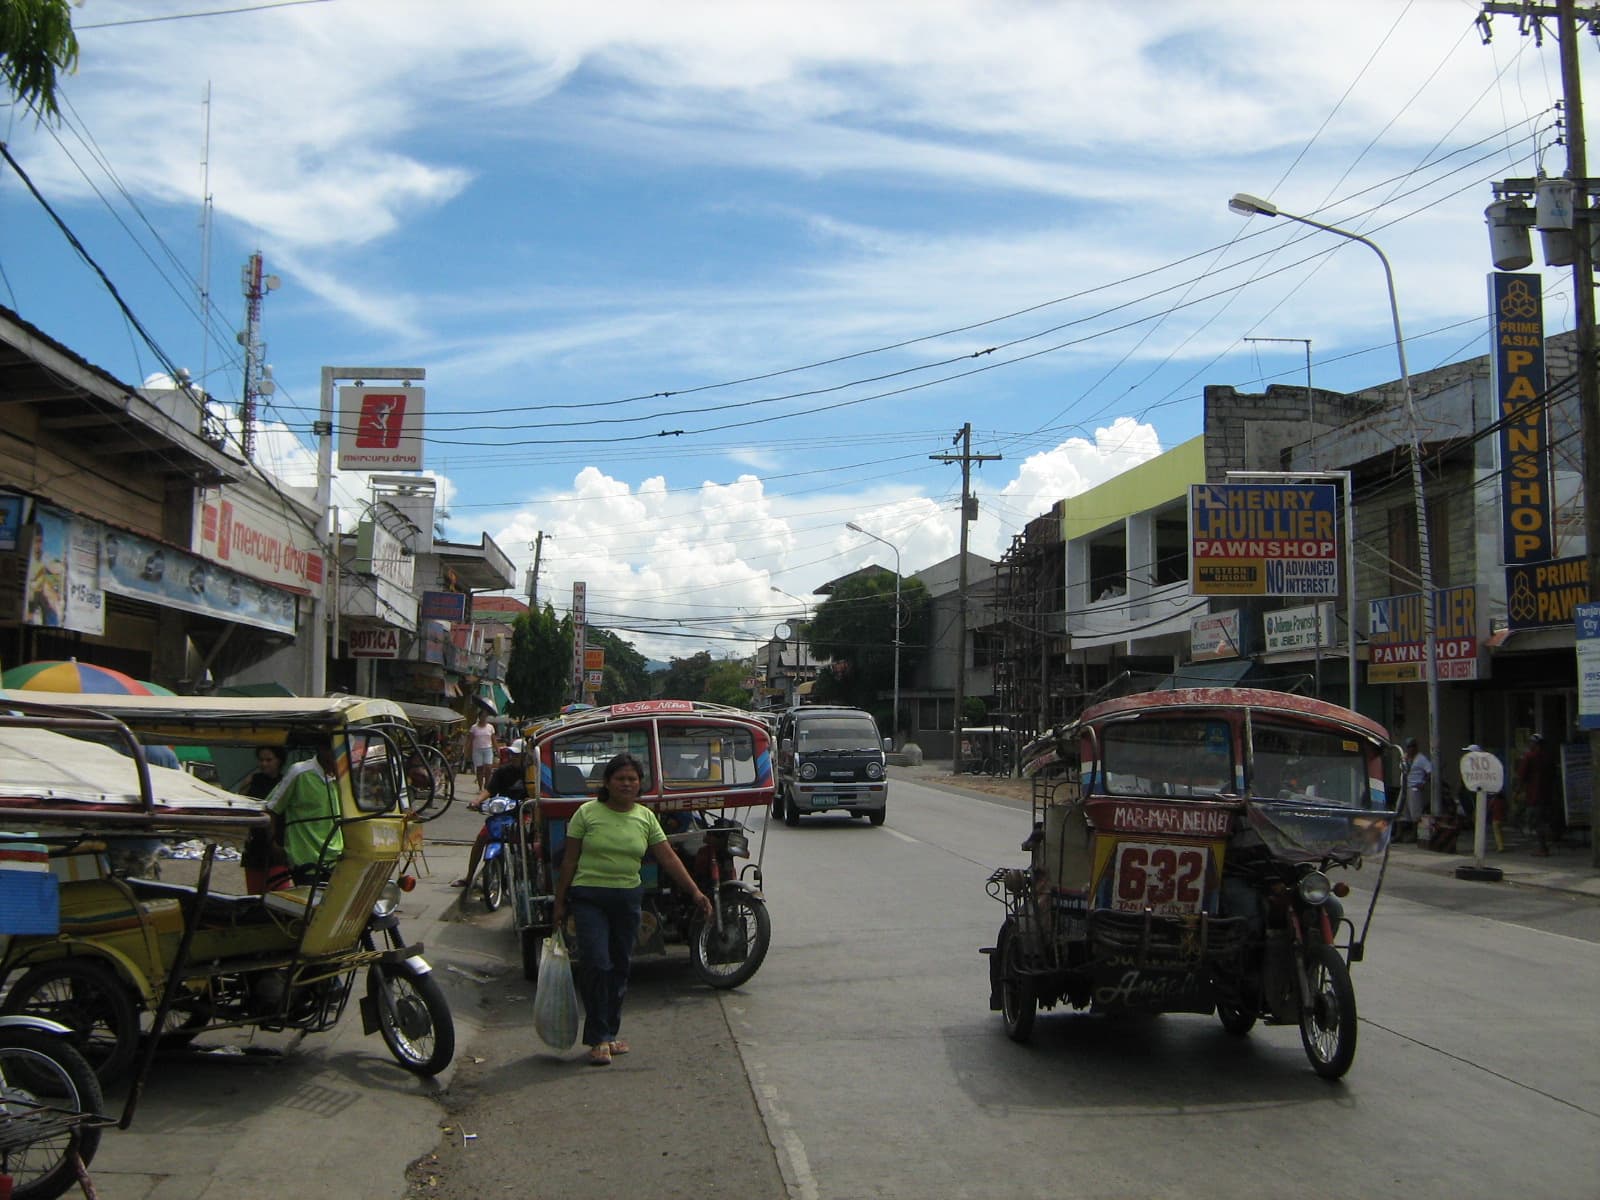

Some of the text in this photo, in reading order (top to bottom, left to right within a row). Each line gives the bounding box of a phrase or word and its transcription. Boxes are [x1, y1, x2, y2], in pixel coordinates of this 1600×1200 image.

[1501, 322, 1539, 333] PRIME
[1501, 335, 1540, 346] ASIA
[343, 454, 417, 464] mercury drug
[1503, 350, 1542, 558] PAWNSHOP
[1228, 490, 1314, 509] HENRY
[1193, 510, 1333, 539] LHUILLIER
[233, 521, 281, 573] mercury
[284, 541, 306, 583] drug
[1196, 541, 1334, 556] PAWNSHOP
[1266, 560, 1334, 593] NO ADVANCED
[1536, 560, 1590, 588] PRIME
[1584, 619, 1598, 631] City
[351, 630, 397, 650] BOTICA
[1470, 757, 1490, 771] NO
[1114, 807, 1180, 829] MAR-MAR
[1118, 848, 1203, 902] 632
